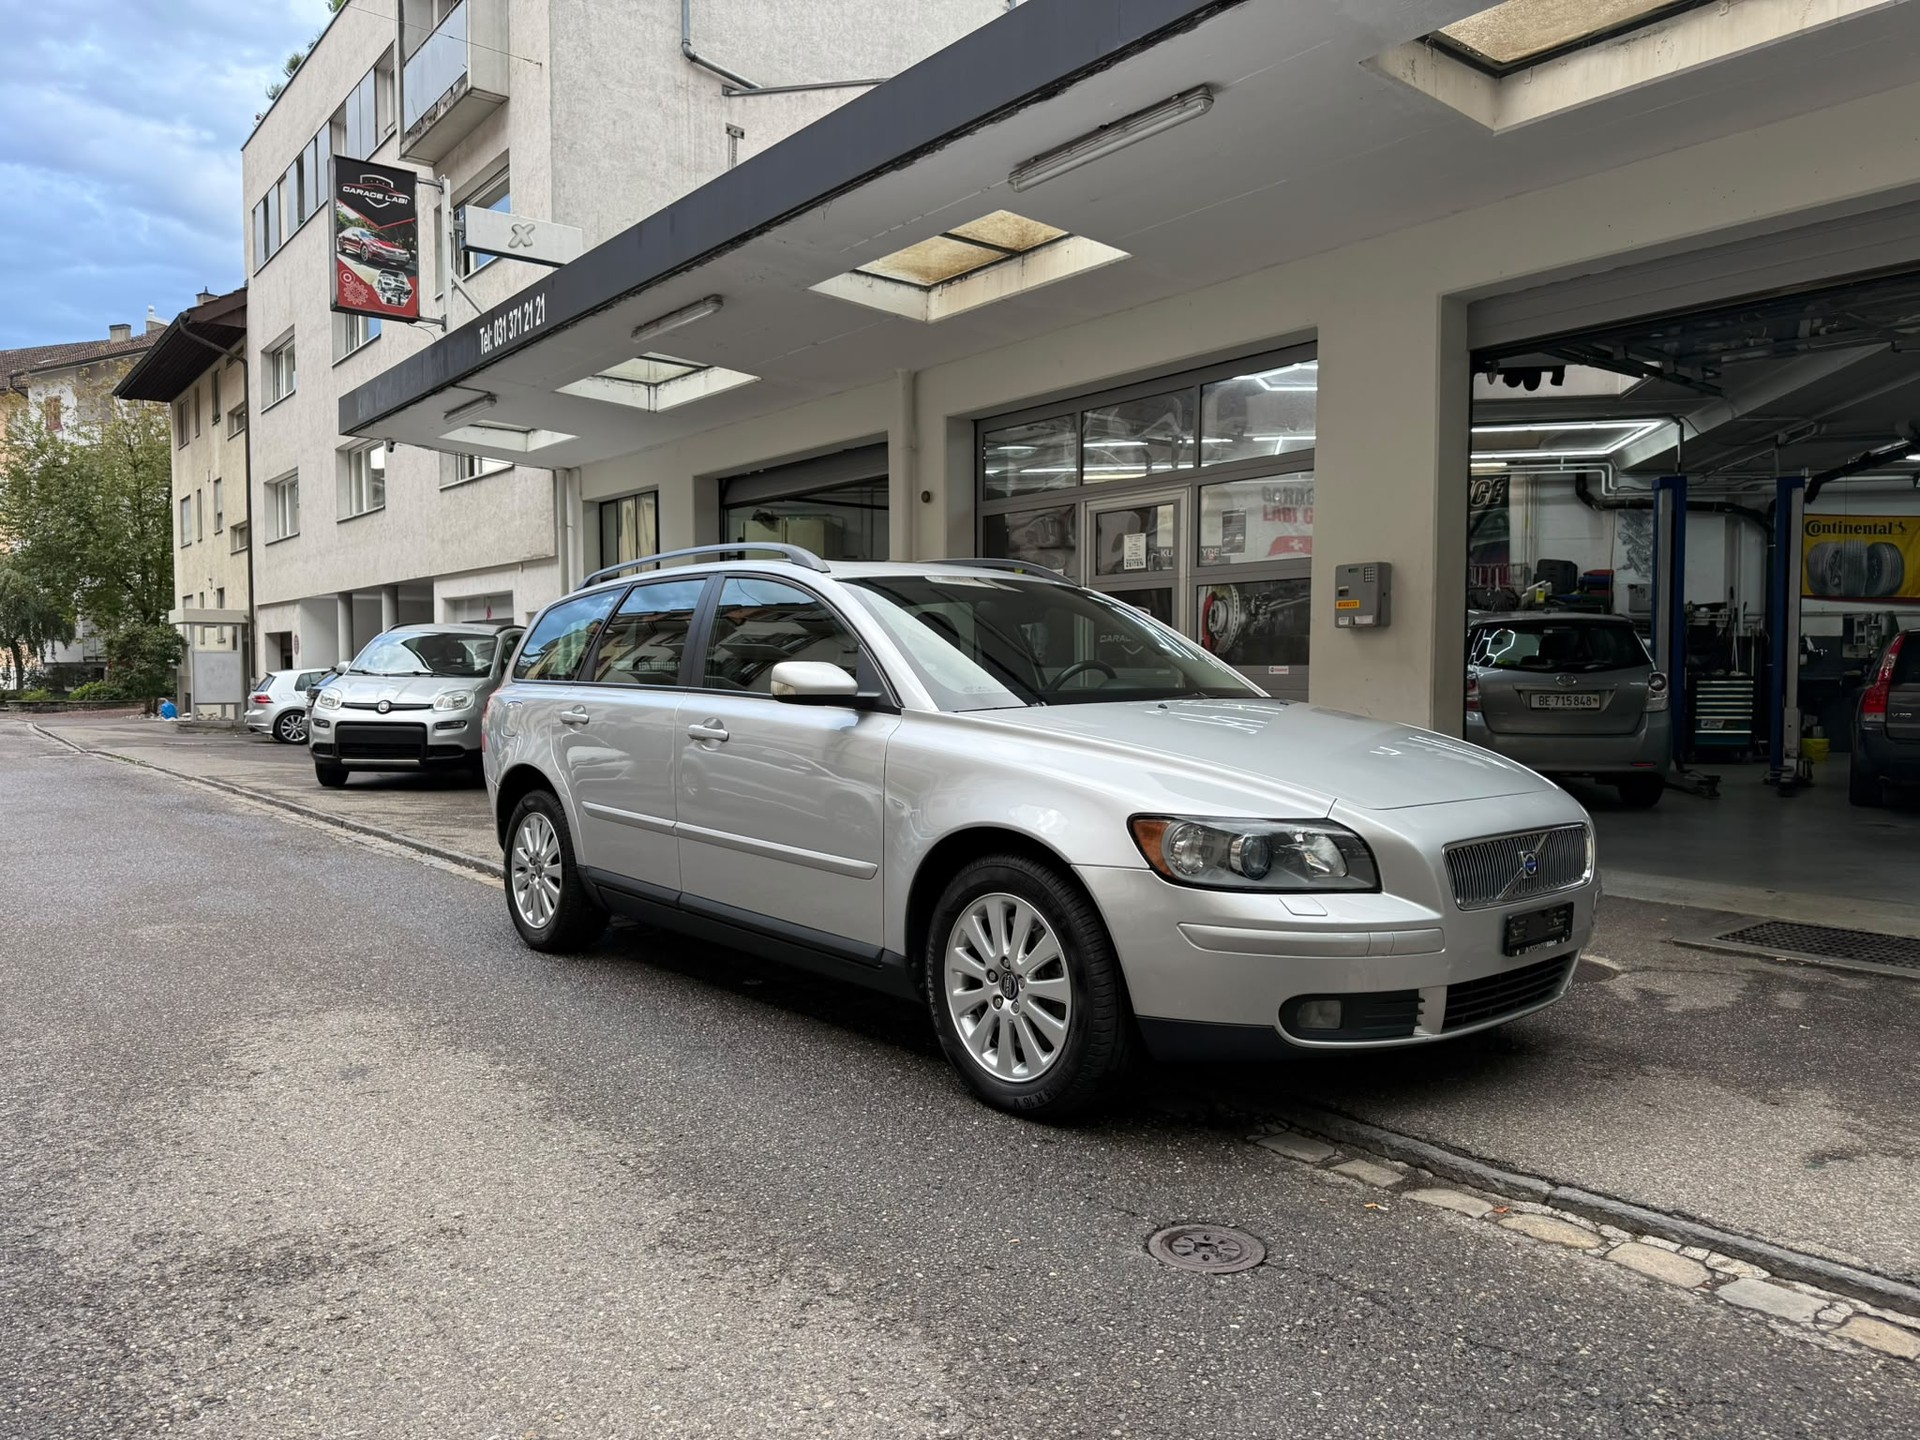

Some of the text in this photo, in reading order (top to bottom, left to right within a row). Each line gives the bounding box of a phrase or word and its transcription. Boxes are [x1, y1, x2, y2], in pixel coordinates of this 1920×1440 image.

[342, 186, 408, 205] GARAGE LABI
[480, 292, 545, 355] Tel: 031 371 21 21
[1262, 486, 1314, 506] GARAG
[1804, 520, 1893, 537] Continental
[1160, 548, 1174, 558] KU
